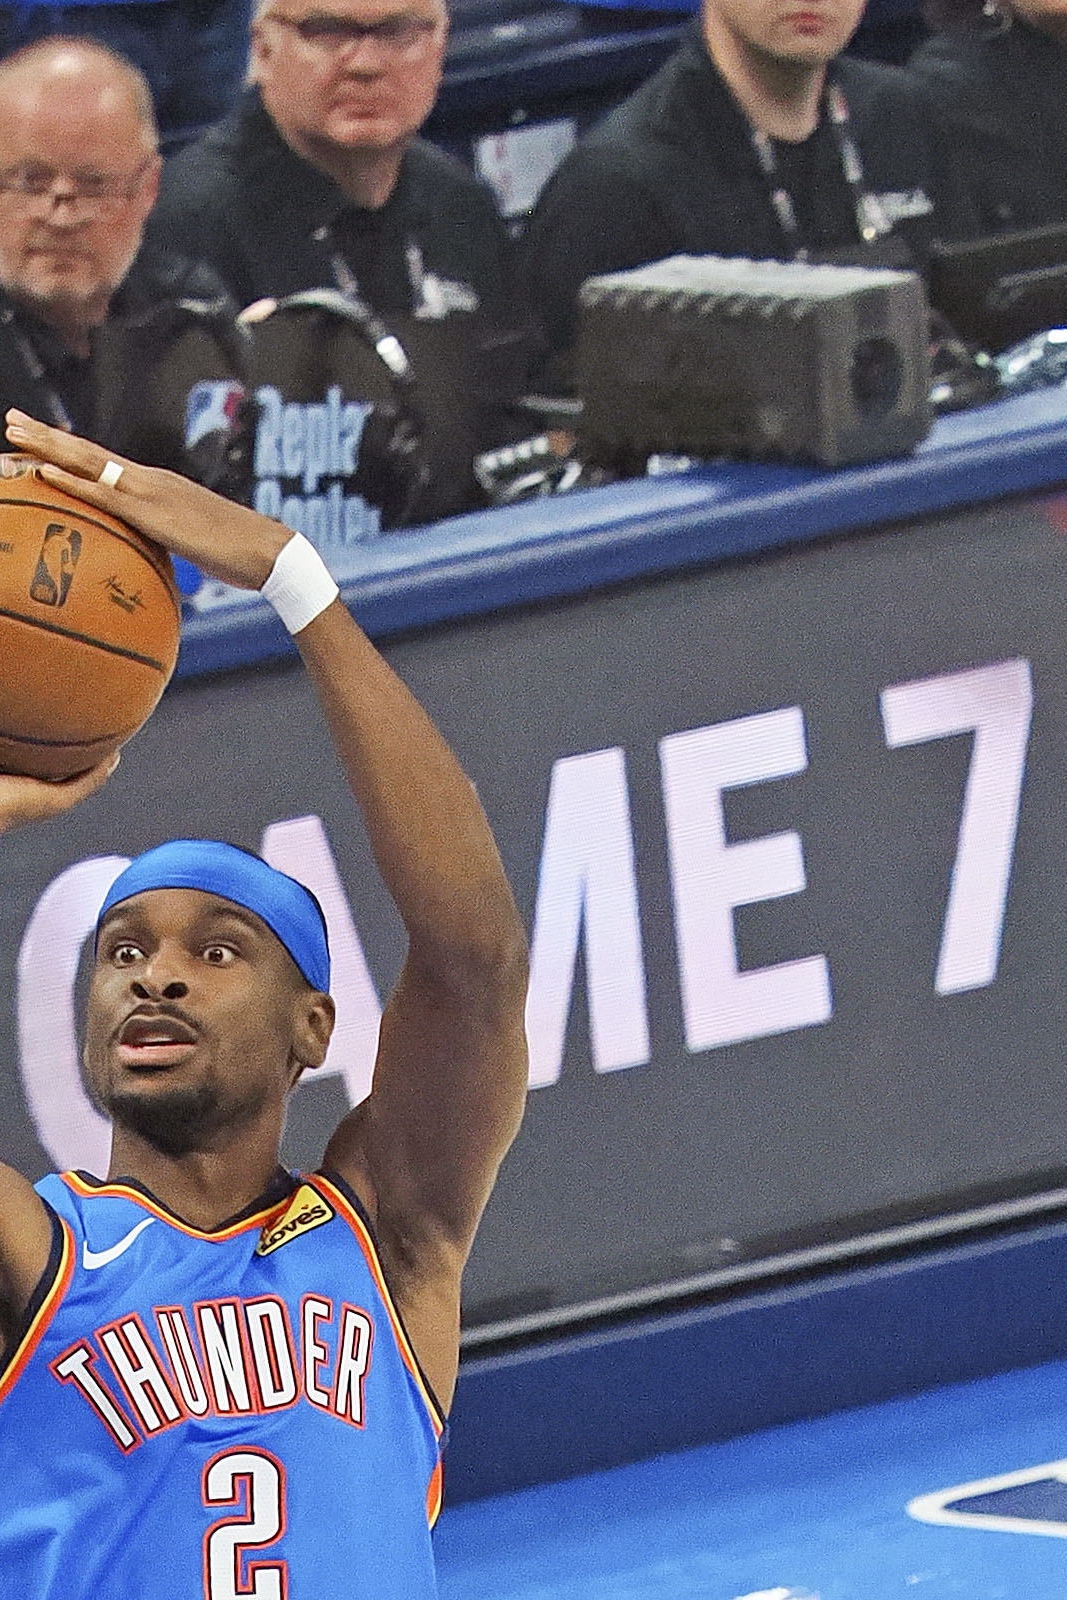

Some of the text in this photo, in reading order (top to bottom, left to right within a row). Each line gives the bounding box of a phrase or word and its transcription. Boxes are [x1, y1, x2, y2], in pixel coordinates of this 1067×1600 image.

[251, 384, 374, 494] Repla
[879, 657, 1034, 997] 7
[48, 1292, 376, 1456] THUNDER
